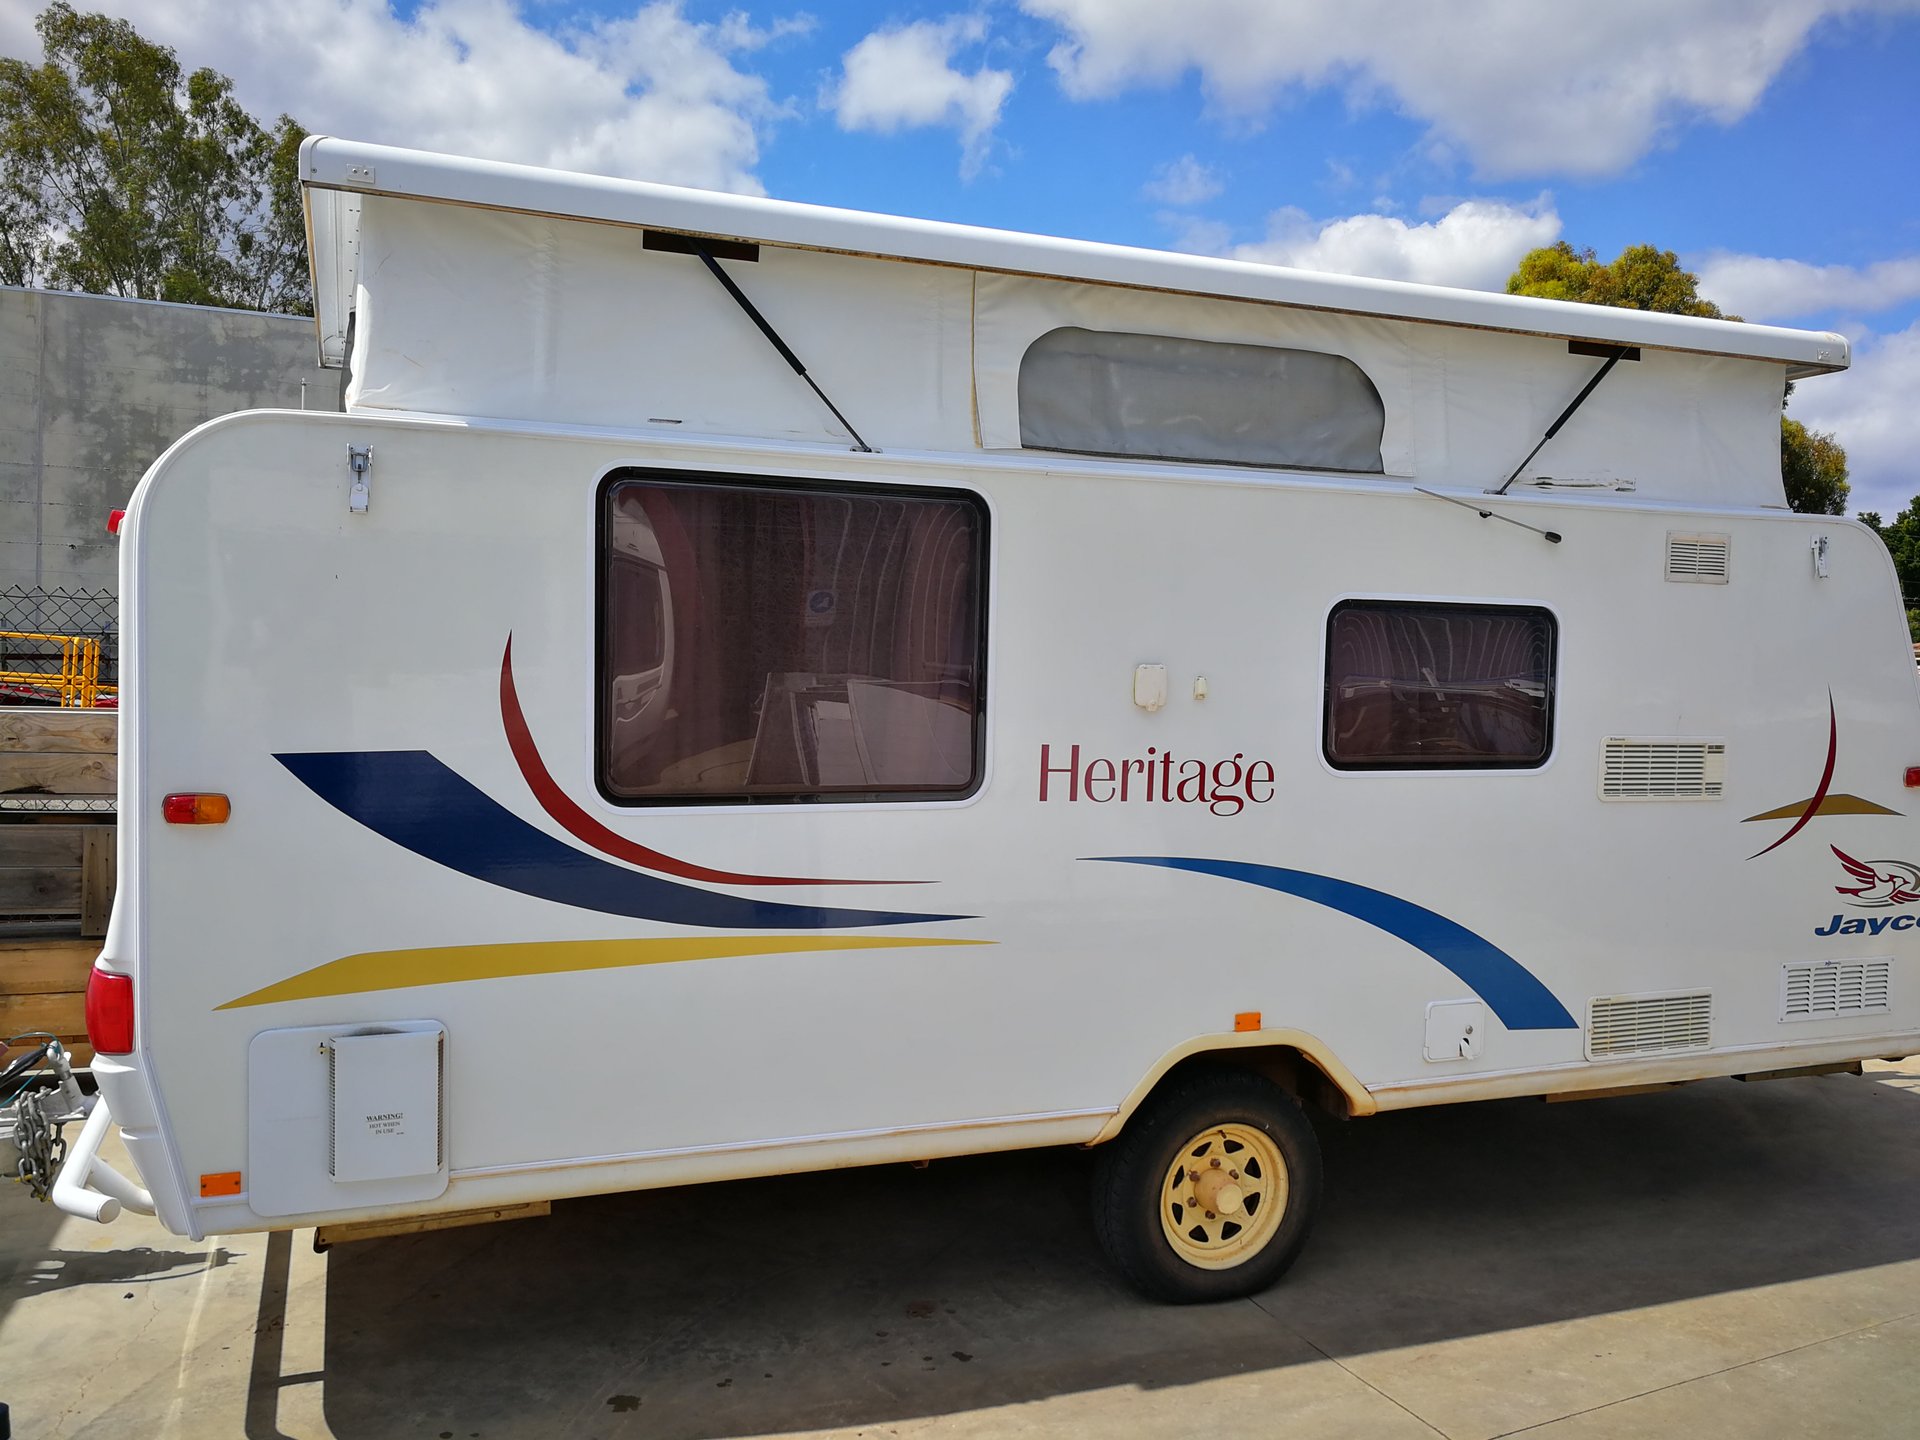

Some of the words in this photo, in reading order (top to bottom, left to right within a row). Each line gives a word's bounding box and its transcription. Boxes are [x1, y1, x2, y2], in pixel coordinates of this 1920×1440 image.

[1038, 743, 1276, 817] Heritage
[1814, 914, 1920, 936] Jayc
[366, 1113, 403, 1122] WARNING!
